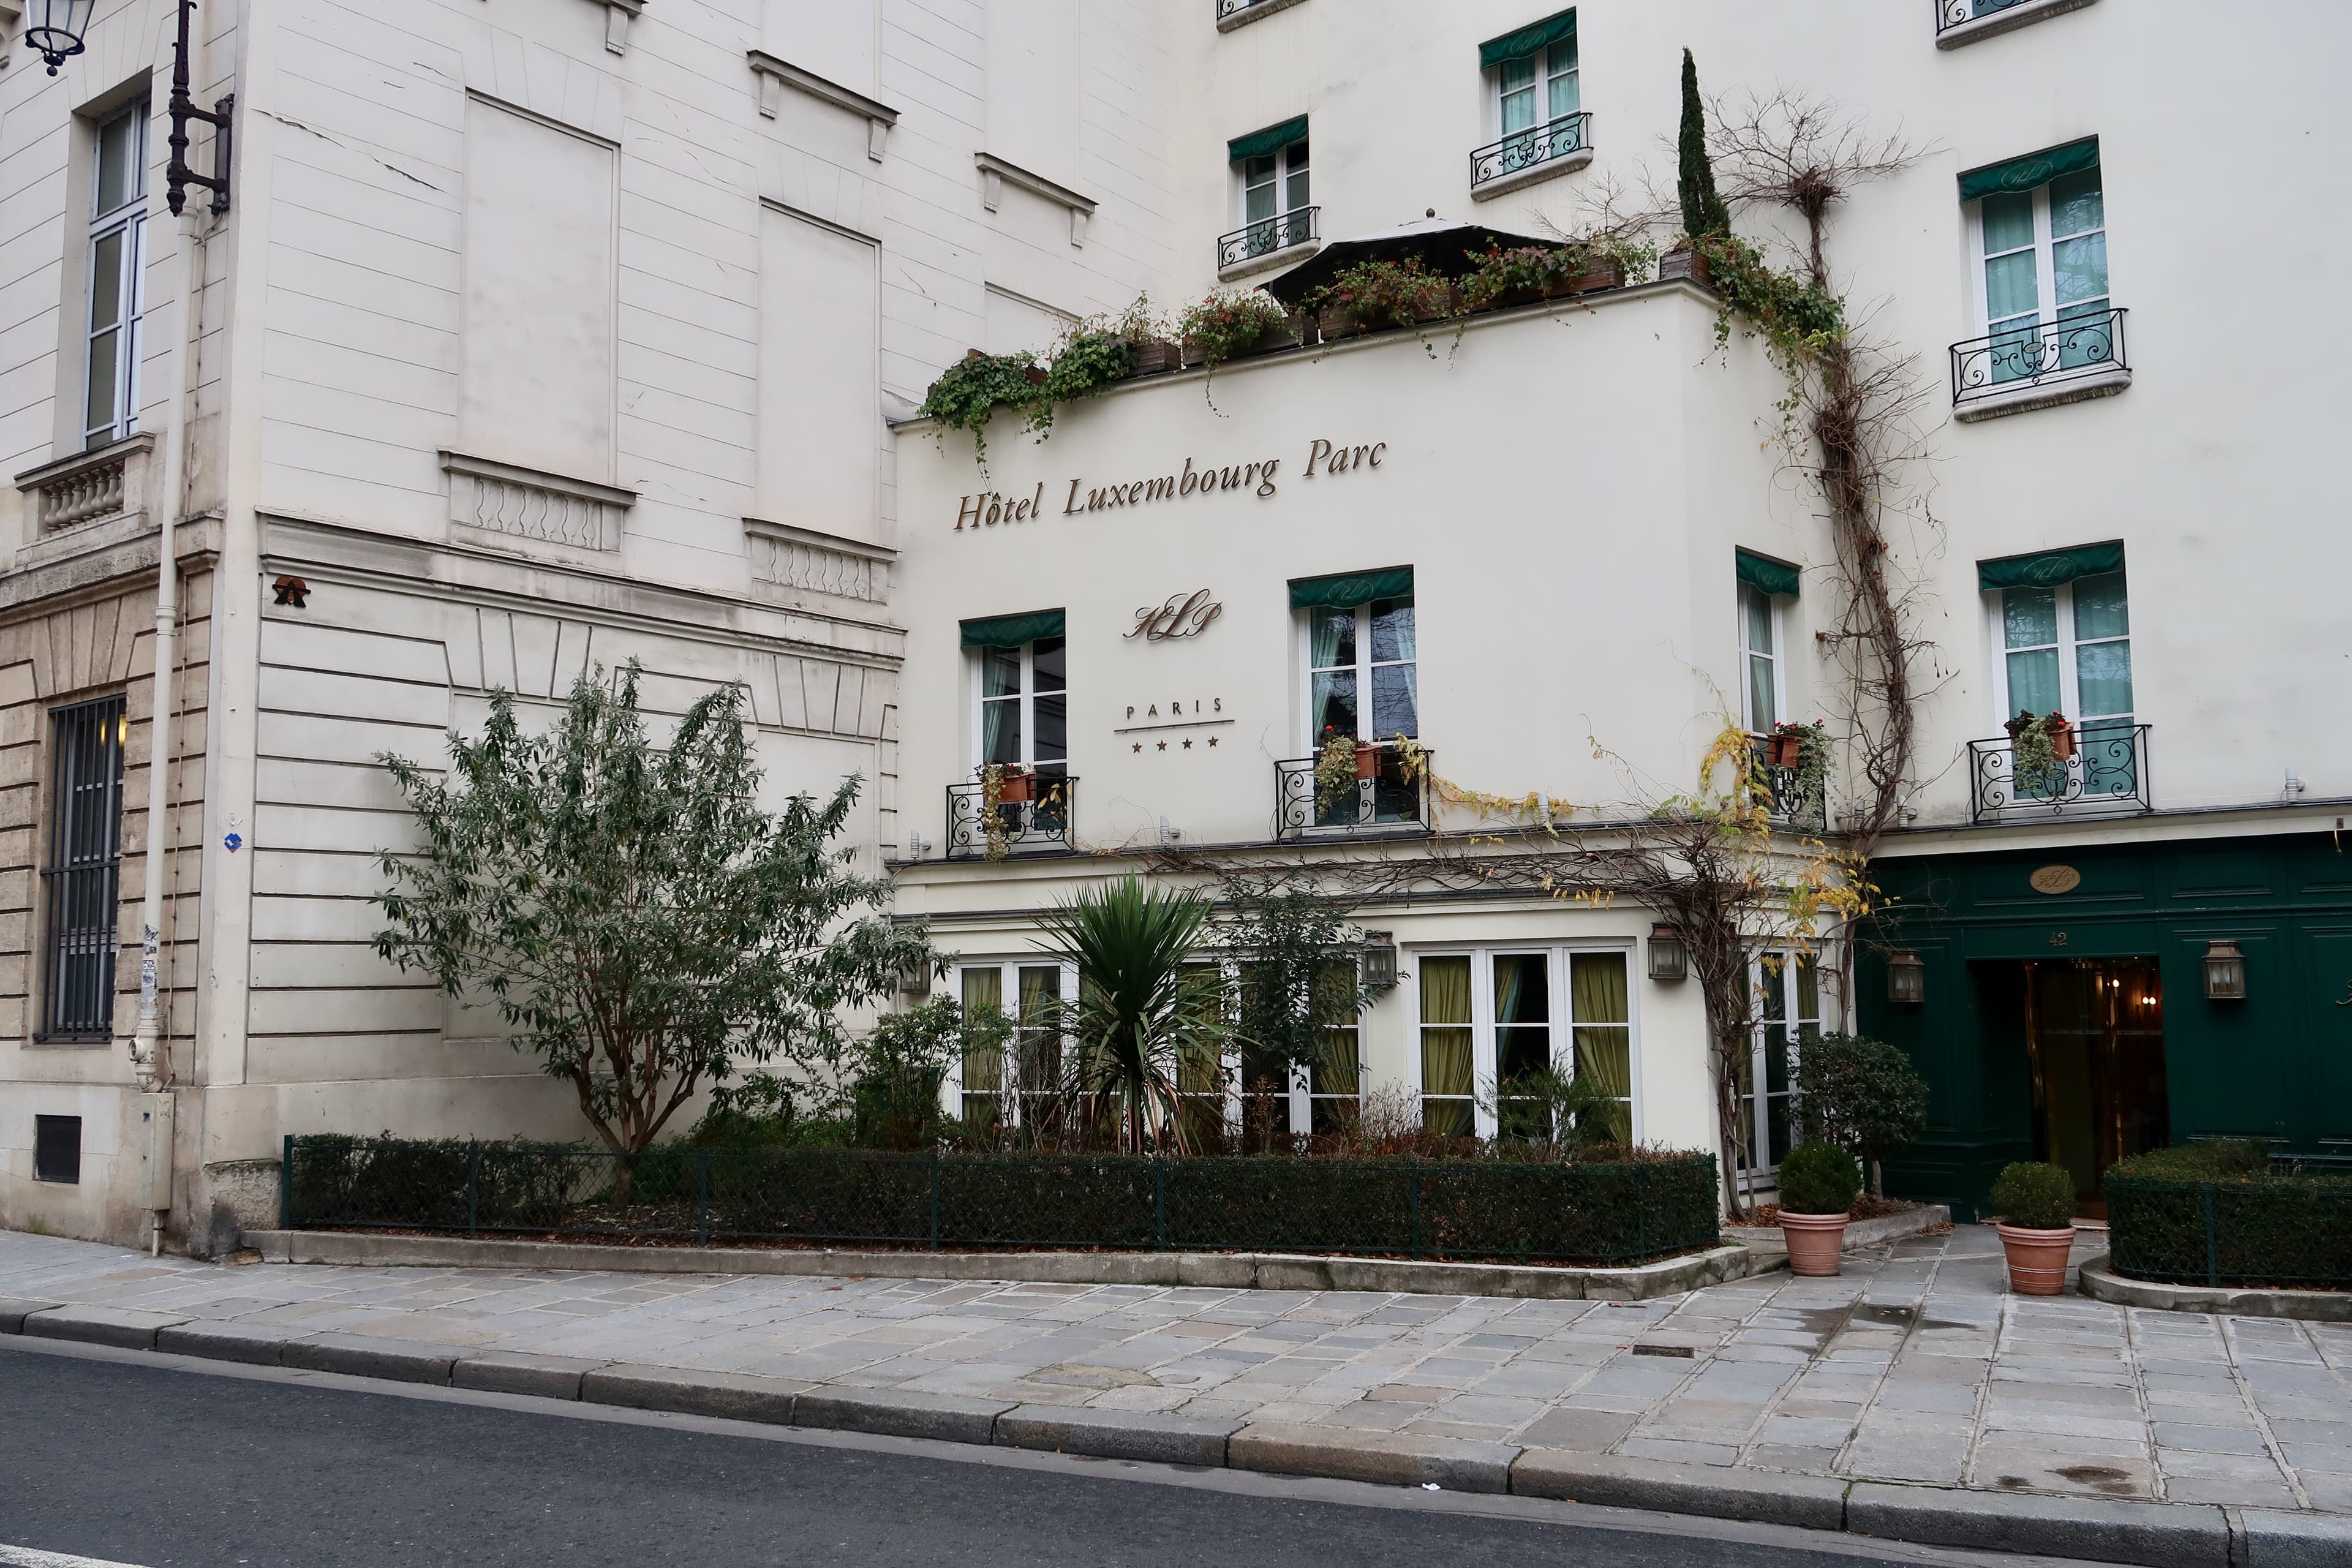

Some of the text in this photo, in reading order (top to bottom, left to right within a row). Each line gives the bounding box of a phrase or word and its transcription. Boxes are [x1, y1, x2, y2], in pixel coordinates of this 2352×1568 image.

[953, 439, 1387, 531] Hôtel Luxembourg Parc
[1126, 698, 1221, 719] PARIS
[2049, 932, 2068, 946] 42
